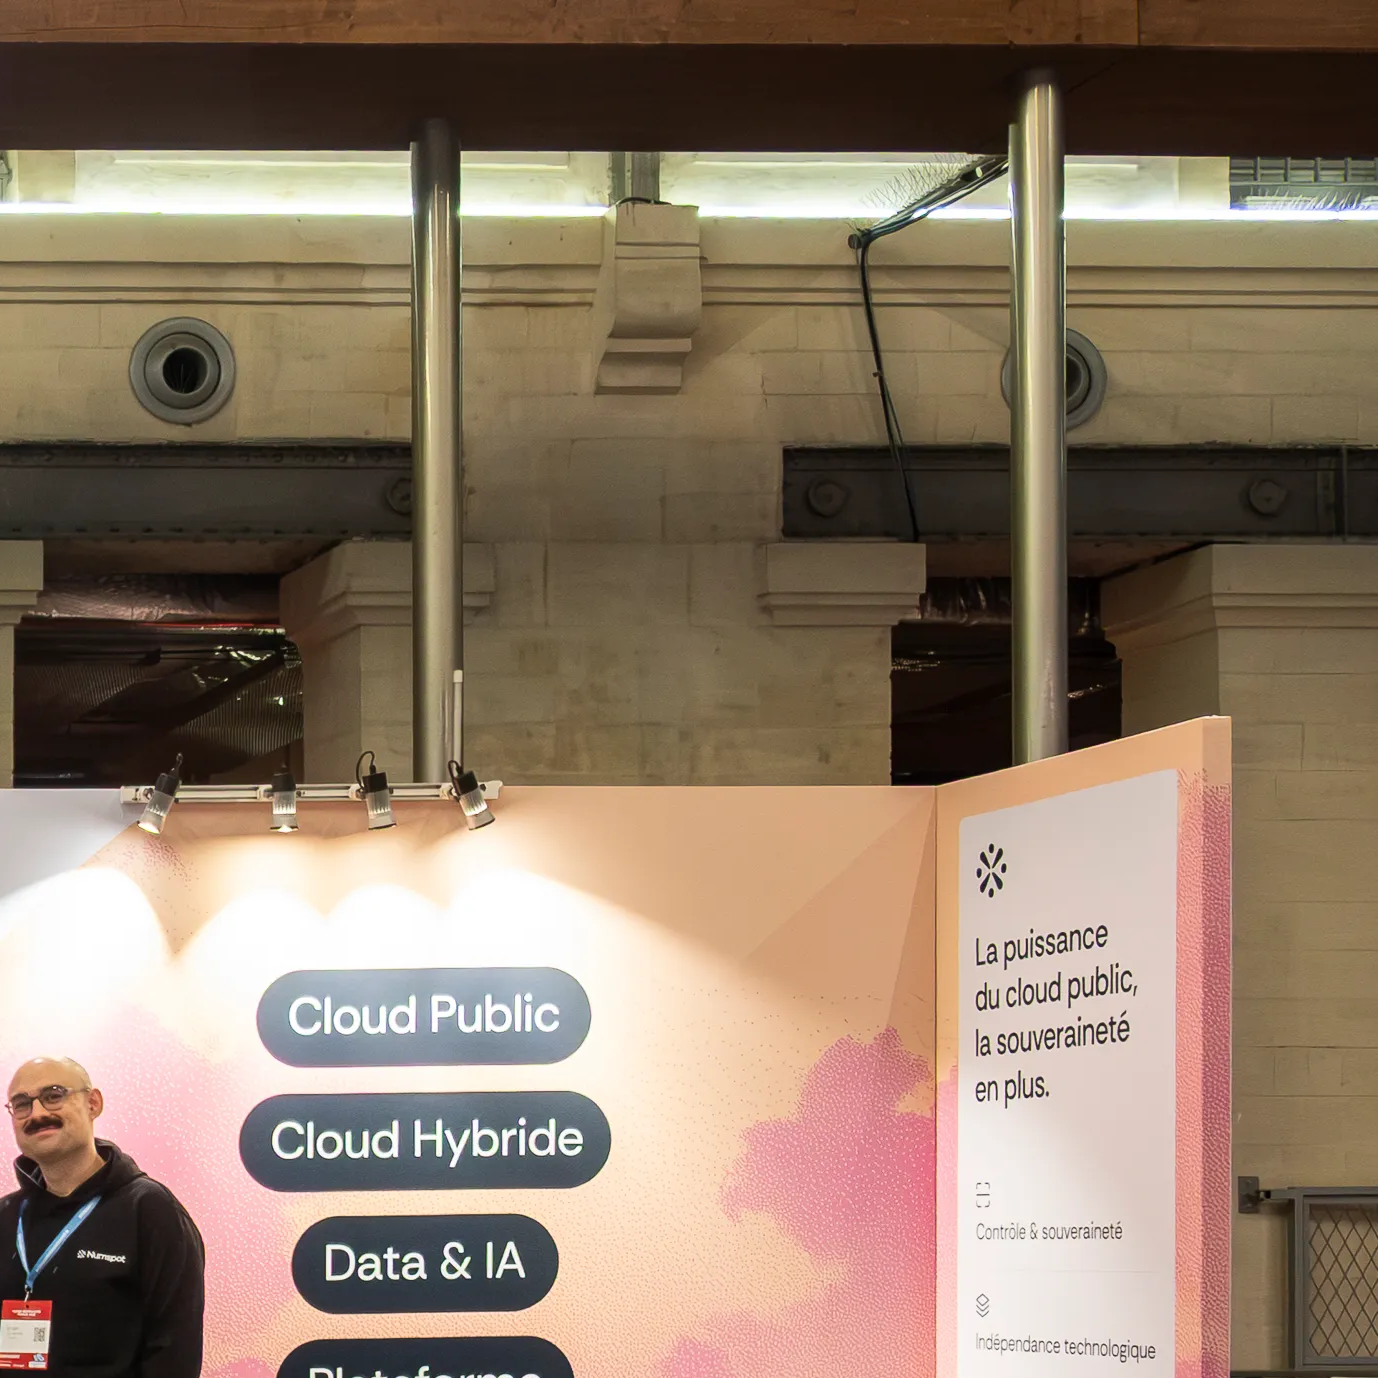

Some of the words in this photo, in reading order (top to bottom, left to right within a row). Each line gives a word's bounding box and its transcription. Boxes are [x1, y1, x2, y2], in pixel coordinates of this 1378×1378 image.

[975, 937, 999, 966] La
[1004, 924, 1108, 970] puissance
[975, 981, 1000, 1012] du
[1005, 972, 1062, 1008] cloud
[1067, 963, 1138, 1008] public,
[288, 993, 417, 1036] Cloud
[430, 992, 560, 1034] Public
[975, 1028, 992, 1057] la
[996, 1010, 1130, 1055] souveraineté
[975, 1080, 999, 1103] en
[1004, 1070, 1050, 1109] plus.
[271, 1119, 400, 1160] Cloud
[413, 1117, 584, 1168] Hybride
[976, 1221, 1026, 1241] Contrôle
[1029, 1221, 1038, 1240] &
[1042, 1220, 1123, 1241] souveraineté
[86, 1250, 126, 1263] Numspot
[325, 1243, 428, 1282] Data
[440, 1241, 472, 1280] &
[486, 1240, 526, 1279] IA
[976, 1332, 1061, 1357] Indépendance
[1064, 1338, 1156, 1364] technologique
